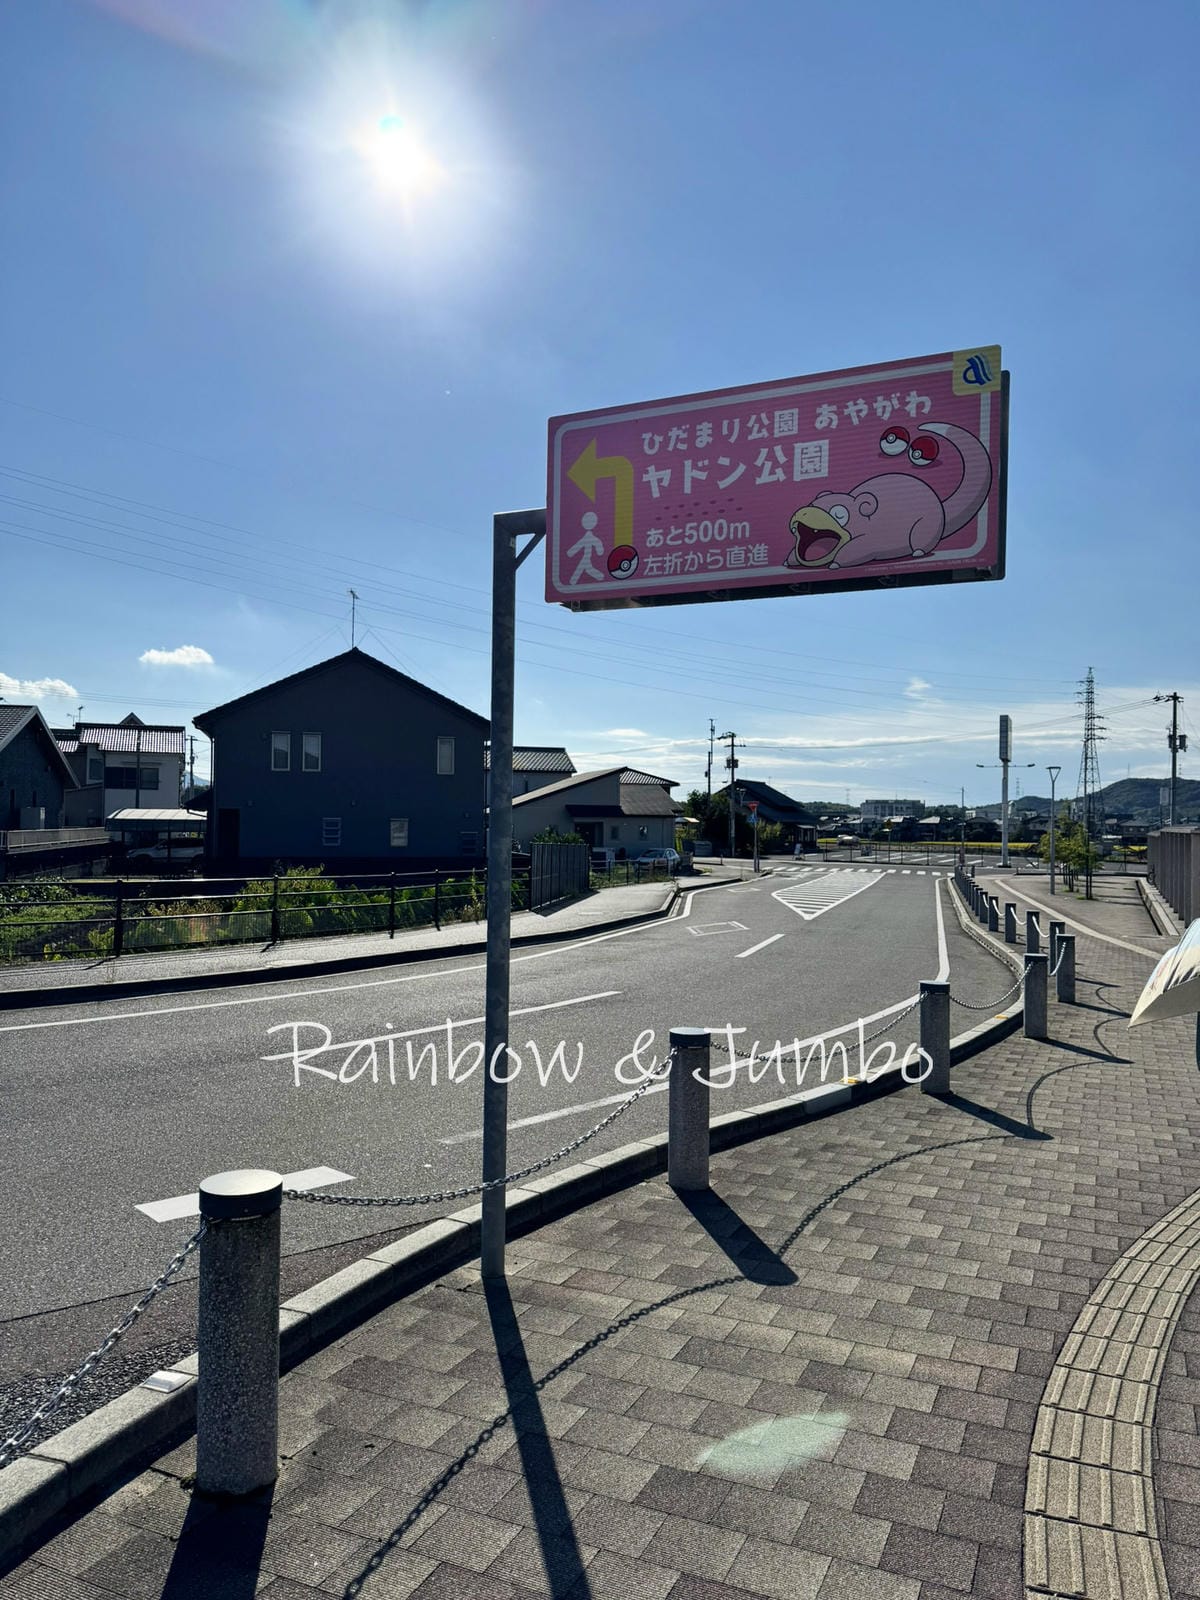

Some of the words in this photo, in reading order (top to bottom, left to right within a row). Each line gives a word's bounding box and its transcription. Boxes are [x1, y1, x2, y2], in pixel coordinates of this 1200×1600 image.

[641, 408, 799, 455] ひだまり公園
[814, 390, 932, 430] あやがわ
[641, 439, 830, 498] ヤドン公園
[645, 518, 751, 548] あと500m
[643, 543, 769, 576] 左折から直進
